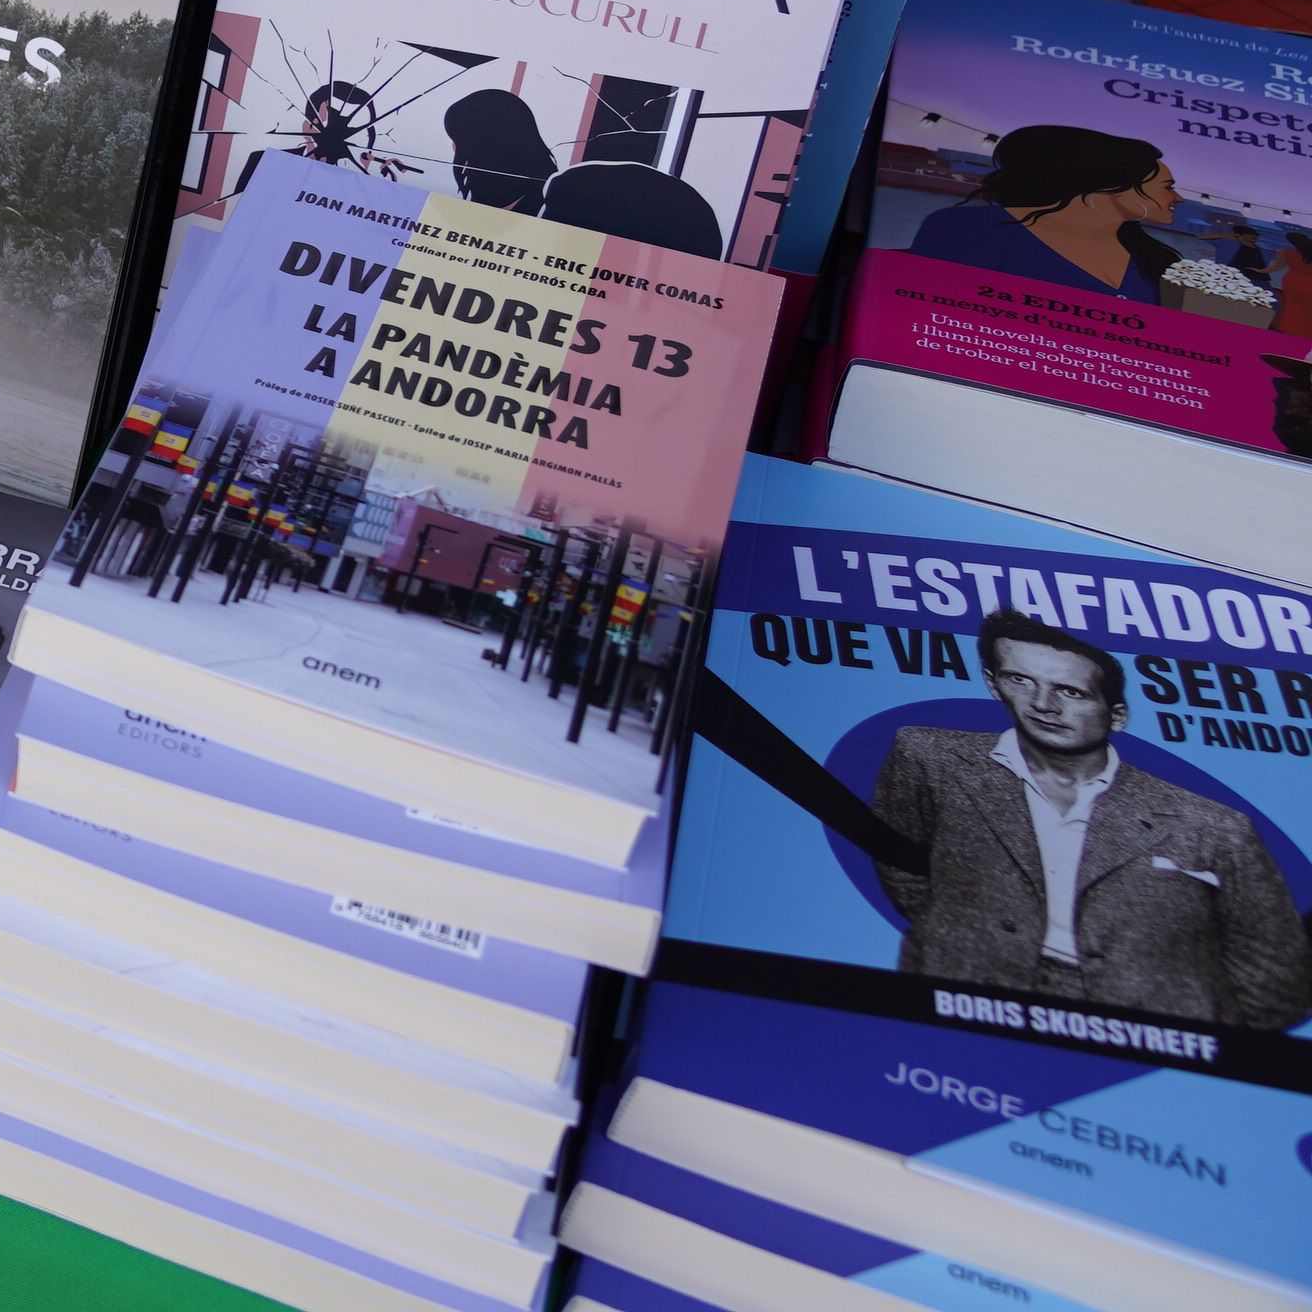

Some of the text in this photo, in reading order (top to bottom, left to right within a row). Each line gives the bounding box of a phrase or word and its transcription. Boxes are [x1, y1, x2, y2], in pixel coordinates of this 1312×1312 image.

[1010, 35, 1245, 93] Rodríguez
[295, 190, 725, 312] JOAN MARTÍNEZ BENAZET ERIC JOVER COMAS
[391, 238, 607, 300] Coordinat per JUDIT PEDRÓS CABA
[279, 241, 694, 379] DIVENDRES 13
[894, 287, 927, 301] en
[932, 294, 1019, 321] menys
[1103, 330, 1233, 368] setmana!
[977, 285, 1146, 331] 2a EDICIÓ
[303, 303, 623, 417] LA PANDÈMIA
[916, 338, 1206, 411] de trobar el teu lloc al món
[923, 324, 1032, 357] lluminosa
[1035, 349, 1096, 372] sobre
[1098, 362, 1212, 398] l'aventura
[930, 312, 975, 331] Una
[1062, 340, 1192, 379] espaterrant
[303, 346, 591, 450] A ANDORRA
[302, 652, 382, 689] anem
[749, 612, 874, 671] QUE
[882, 626, 971, 681] VA
[1135, 654, 1269, 716] SER
[117, 722, 204, 760] EDITORS
[1156, 710, 1312, 757] D'ANDO
[933, 990, 1219, 1063] BORIS SKOSSYREFF
[884, 1061, 1229, 1188] JORGE CEBRIÁN
[1008, 1139, 1094, 1179] anem
[946, 1260, 1032, 1305] anem
